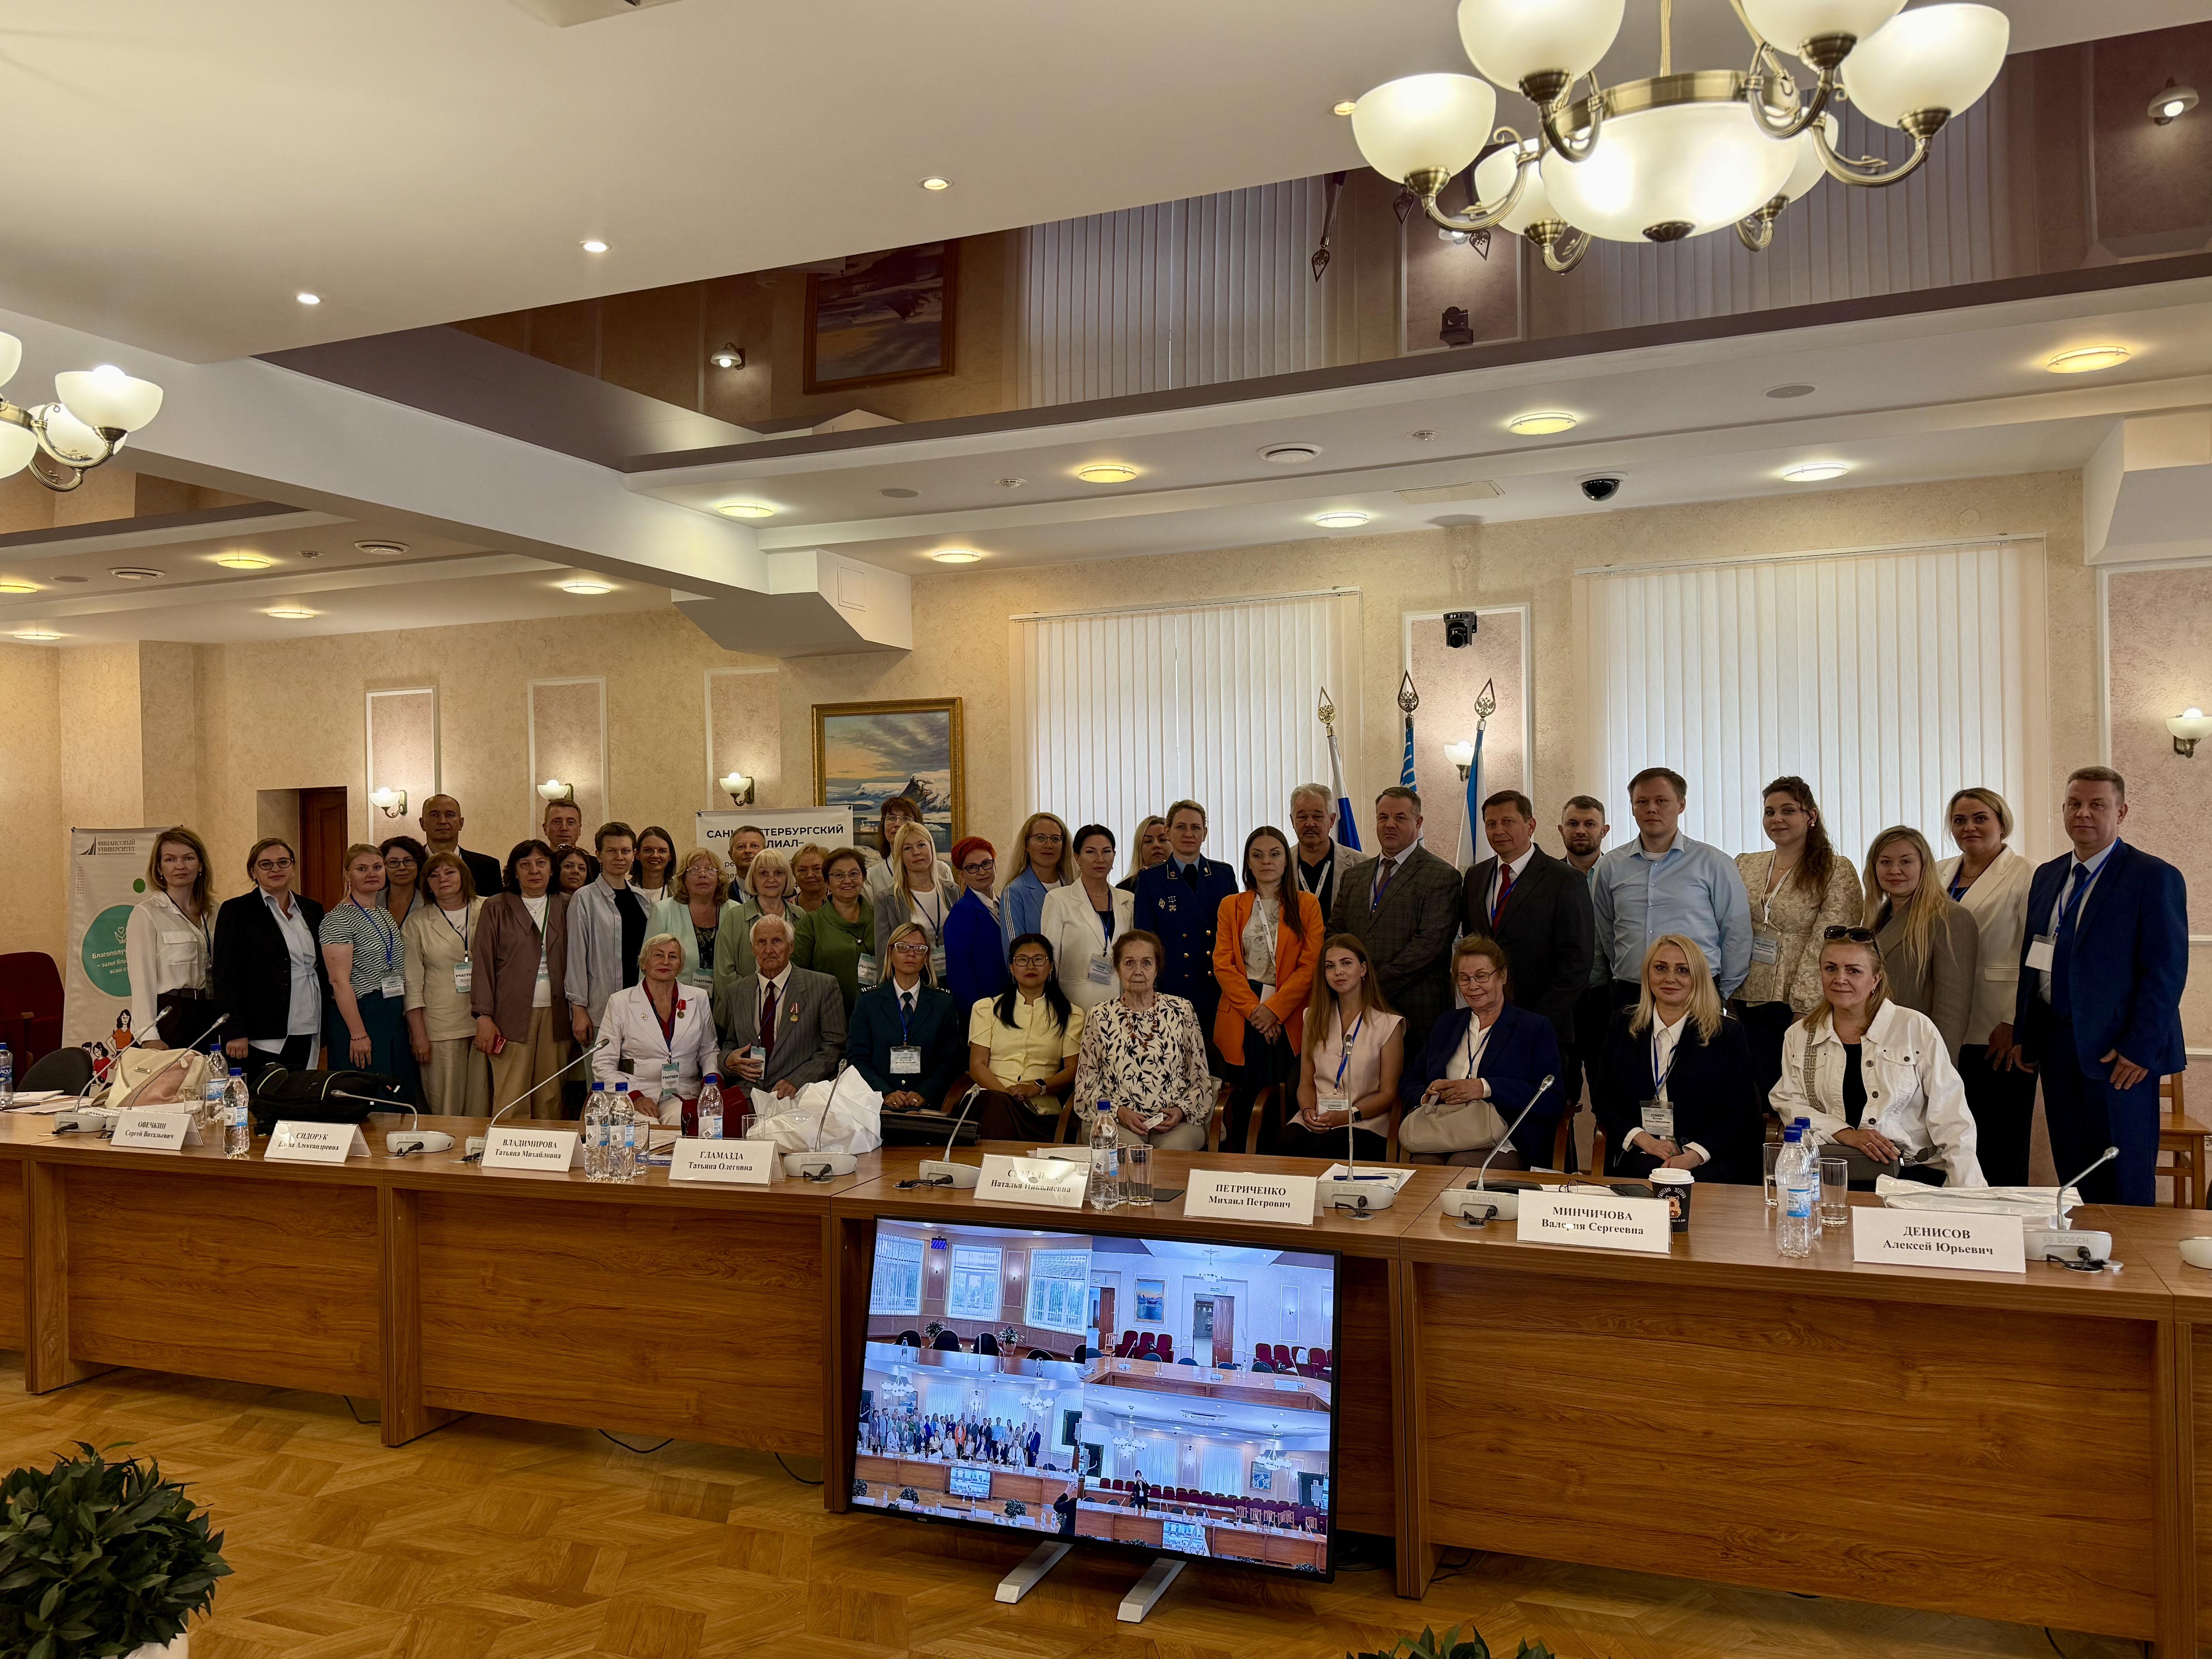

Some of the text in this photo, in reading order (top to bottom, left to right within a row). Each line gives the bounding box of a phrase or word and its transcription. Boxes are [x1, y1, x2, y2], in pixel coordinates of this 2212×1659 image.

[766, 839, 804, 848] ЛИАЛ–
[144, 1131, 174, 1139] Витальевич
[296, 1142, 339, 1151] Александровна
[503, 1139, 557, 1148] ВЛАДИМИРОВА
[522, 1151, 561, 1159] Михайловна
[700, 1151, 744, 1160] ГЛАМАЗДА
[991, 1180, 1071, 1193] Наталья Николаевна
[1216, 1184, 1286, 1195] ПЕТРИЧЕНКО
[1209, 1195, 1290, 1208] Михаил Петрович
[1553, 1206, 1633, 1221] МИНЧИЧОВА
[1589, 1222, 1644, 1235] Сергеевна
[1903, 1226, 1970, 1239] ДЕНИСОВ
[1883, 1240, 1993, 1255] Алексей Юрьевич
